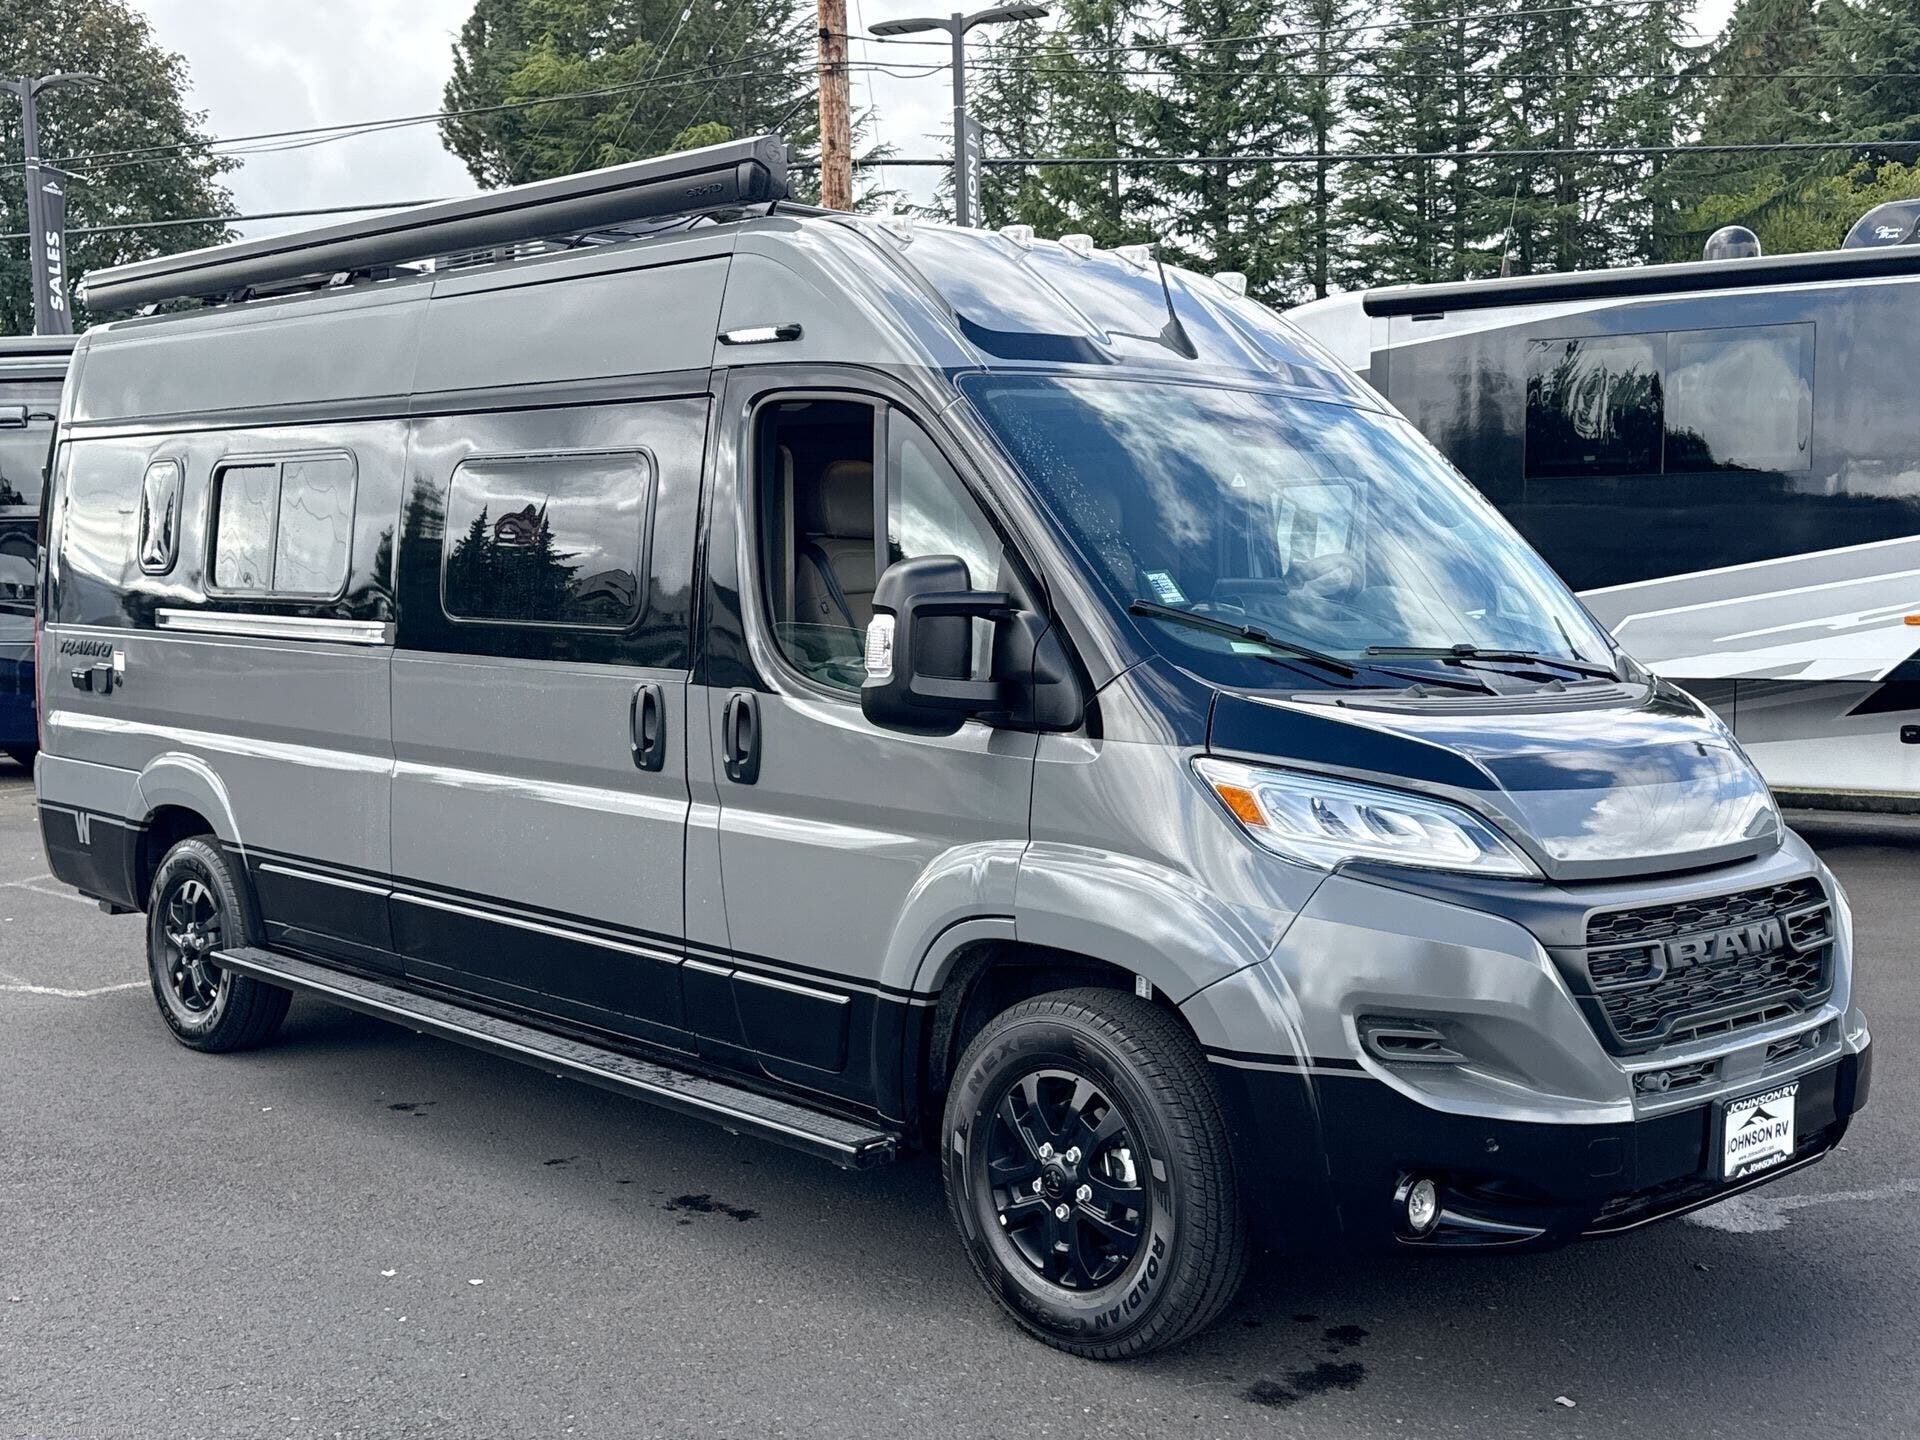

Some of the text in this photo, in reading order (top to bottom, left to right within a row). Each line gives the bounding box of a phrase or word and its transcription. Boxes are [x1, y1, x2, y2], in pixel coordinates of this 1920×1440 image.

[45, 231, 64, 312] SALES
[60, 638, 113, 658] TRAVATO
[1666, 917, 1786, 970] RAM
[1726, 1119, 1789, 1156] JOHNSON RV
[1094, 1231, 1166, 1330] ROADIAN
